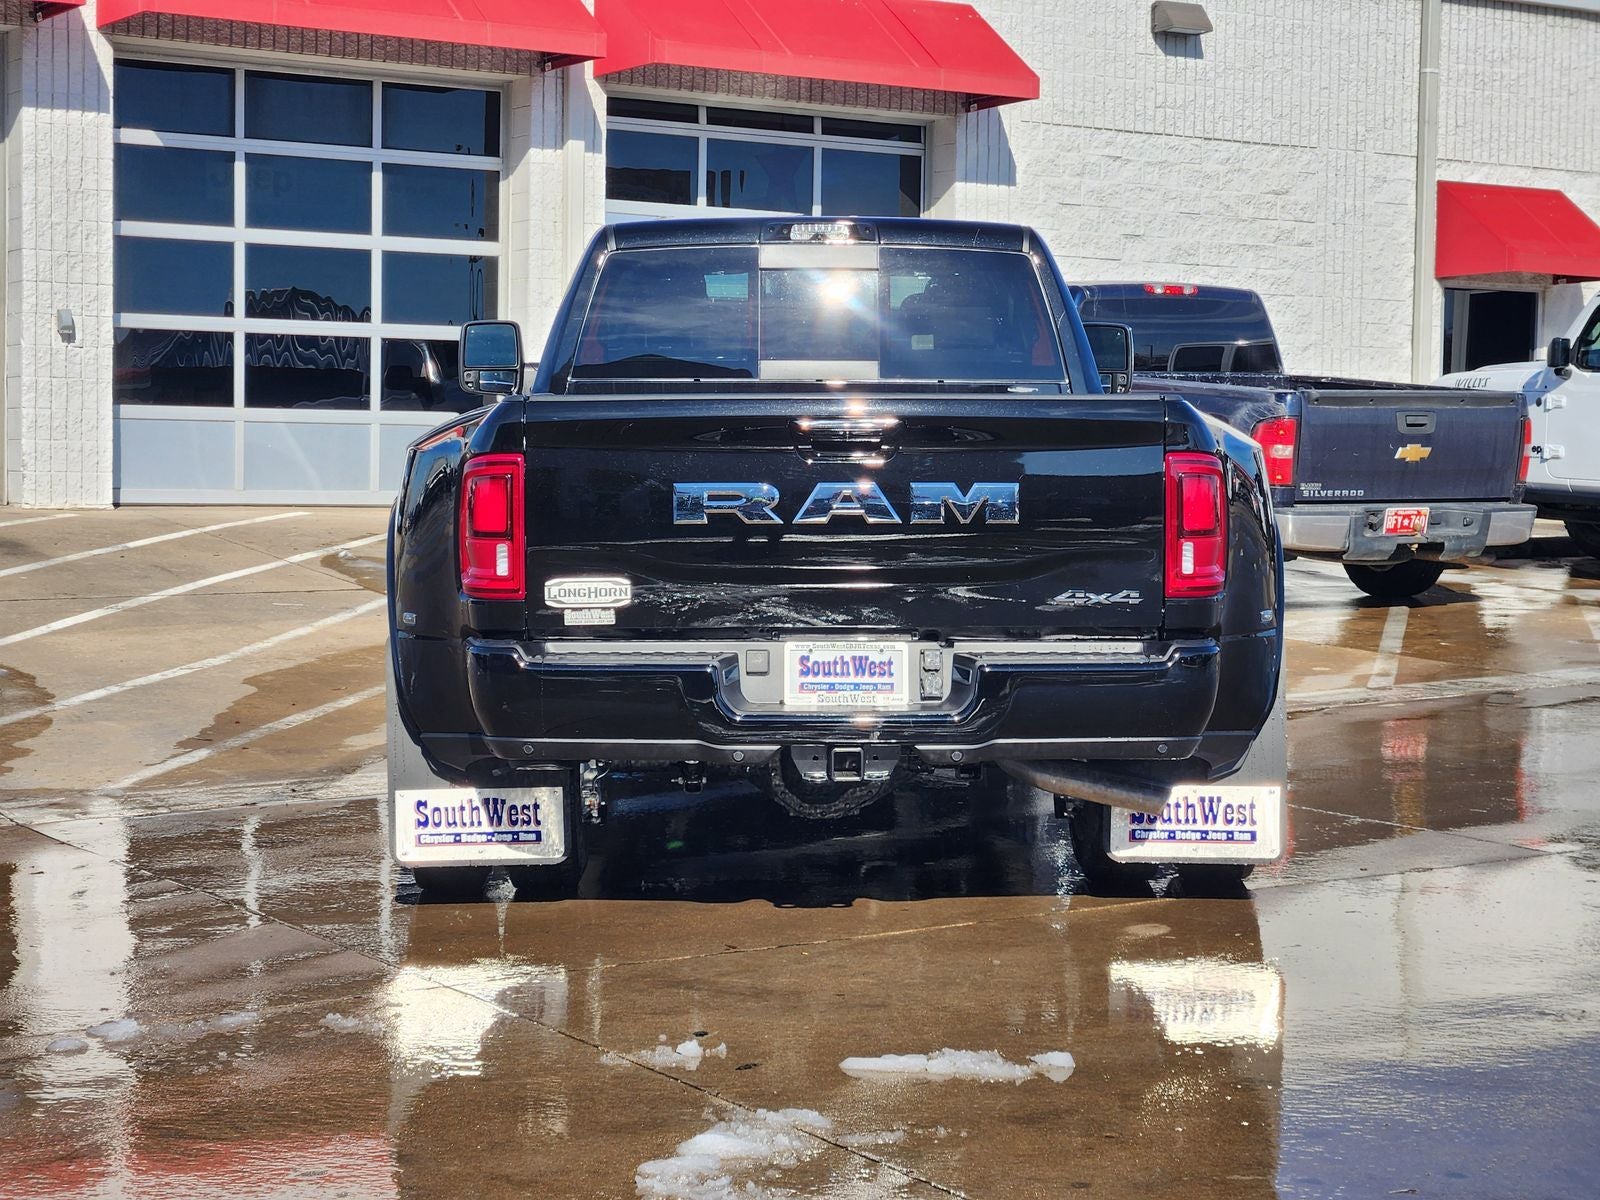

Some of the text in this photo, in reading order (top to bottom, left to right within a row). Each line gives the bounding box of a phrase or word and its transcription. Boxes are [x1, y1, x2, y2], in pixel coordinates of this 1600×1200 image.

[1455, 377, 1491, 388] WILLYS
[1302, 485, 1365, 497] SILVERADO
[673, 482, 1021, 525] RAM
[799, 654, 895, 678] SouthWest
[803, 682, 892, 693] Chrysler Dodge Jeep Ram
[817, 694, 878, 704] SouthWest
[415, 797, 542, 830] SouthWest
[420, 831, 537, 845] Chrysler Dodge Jeep Ram
[1134, 829, 1251, 842] Chrysler Dodge Jeep Ram
